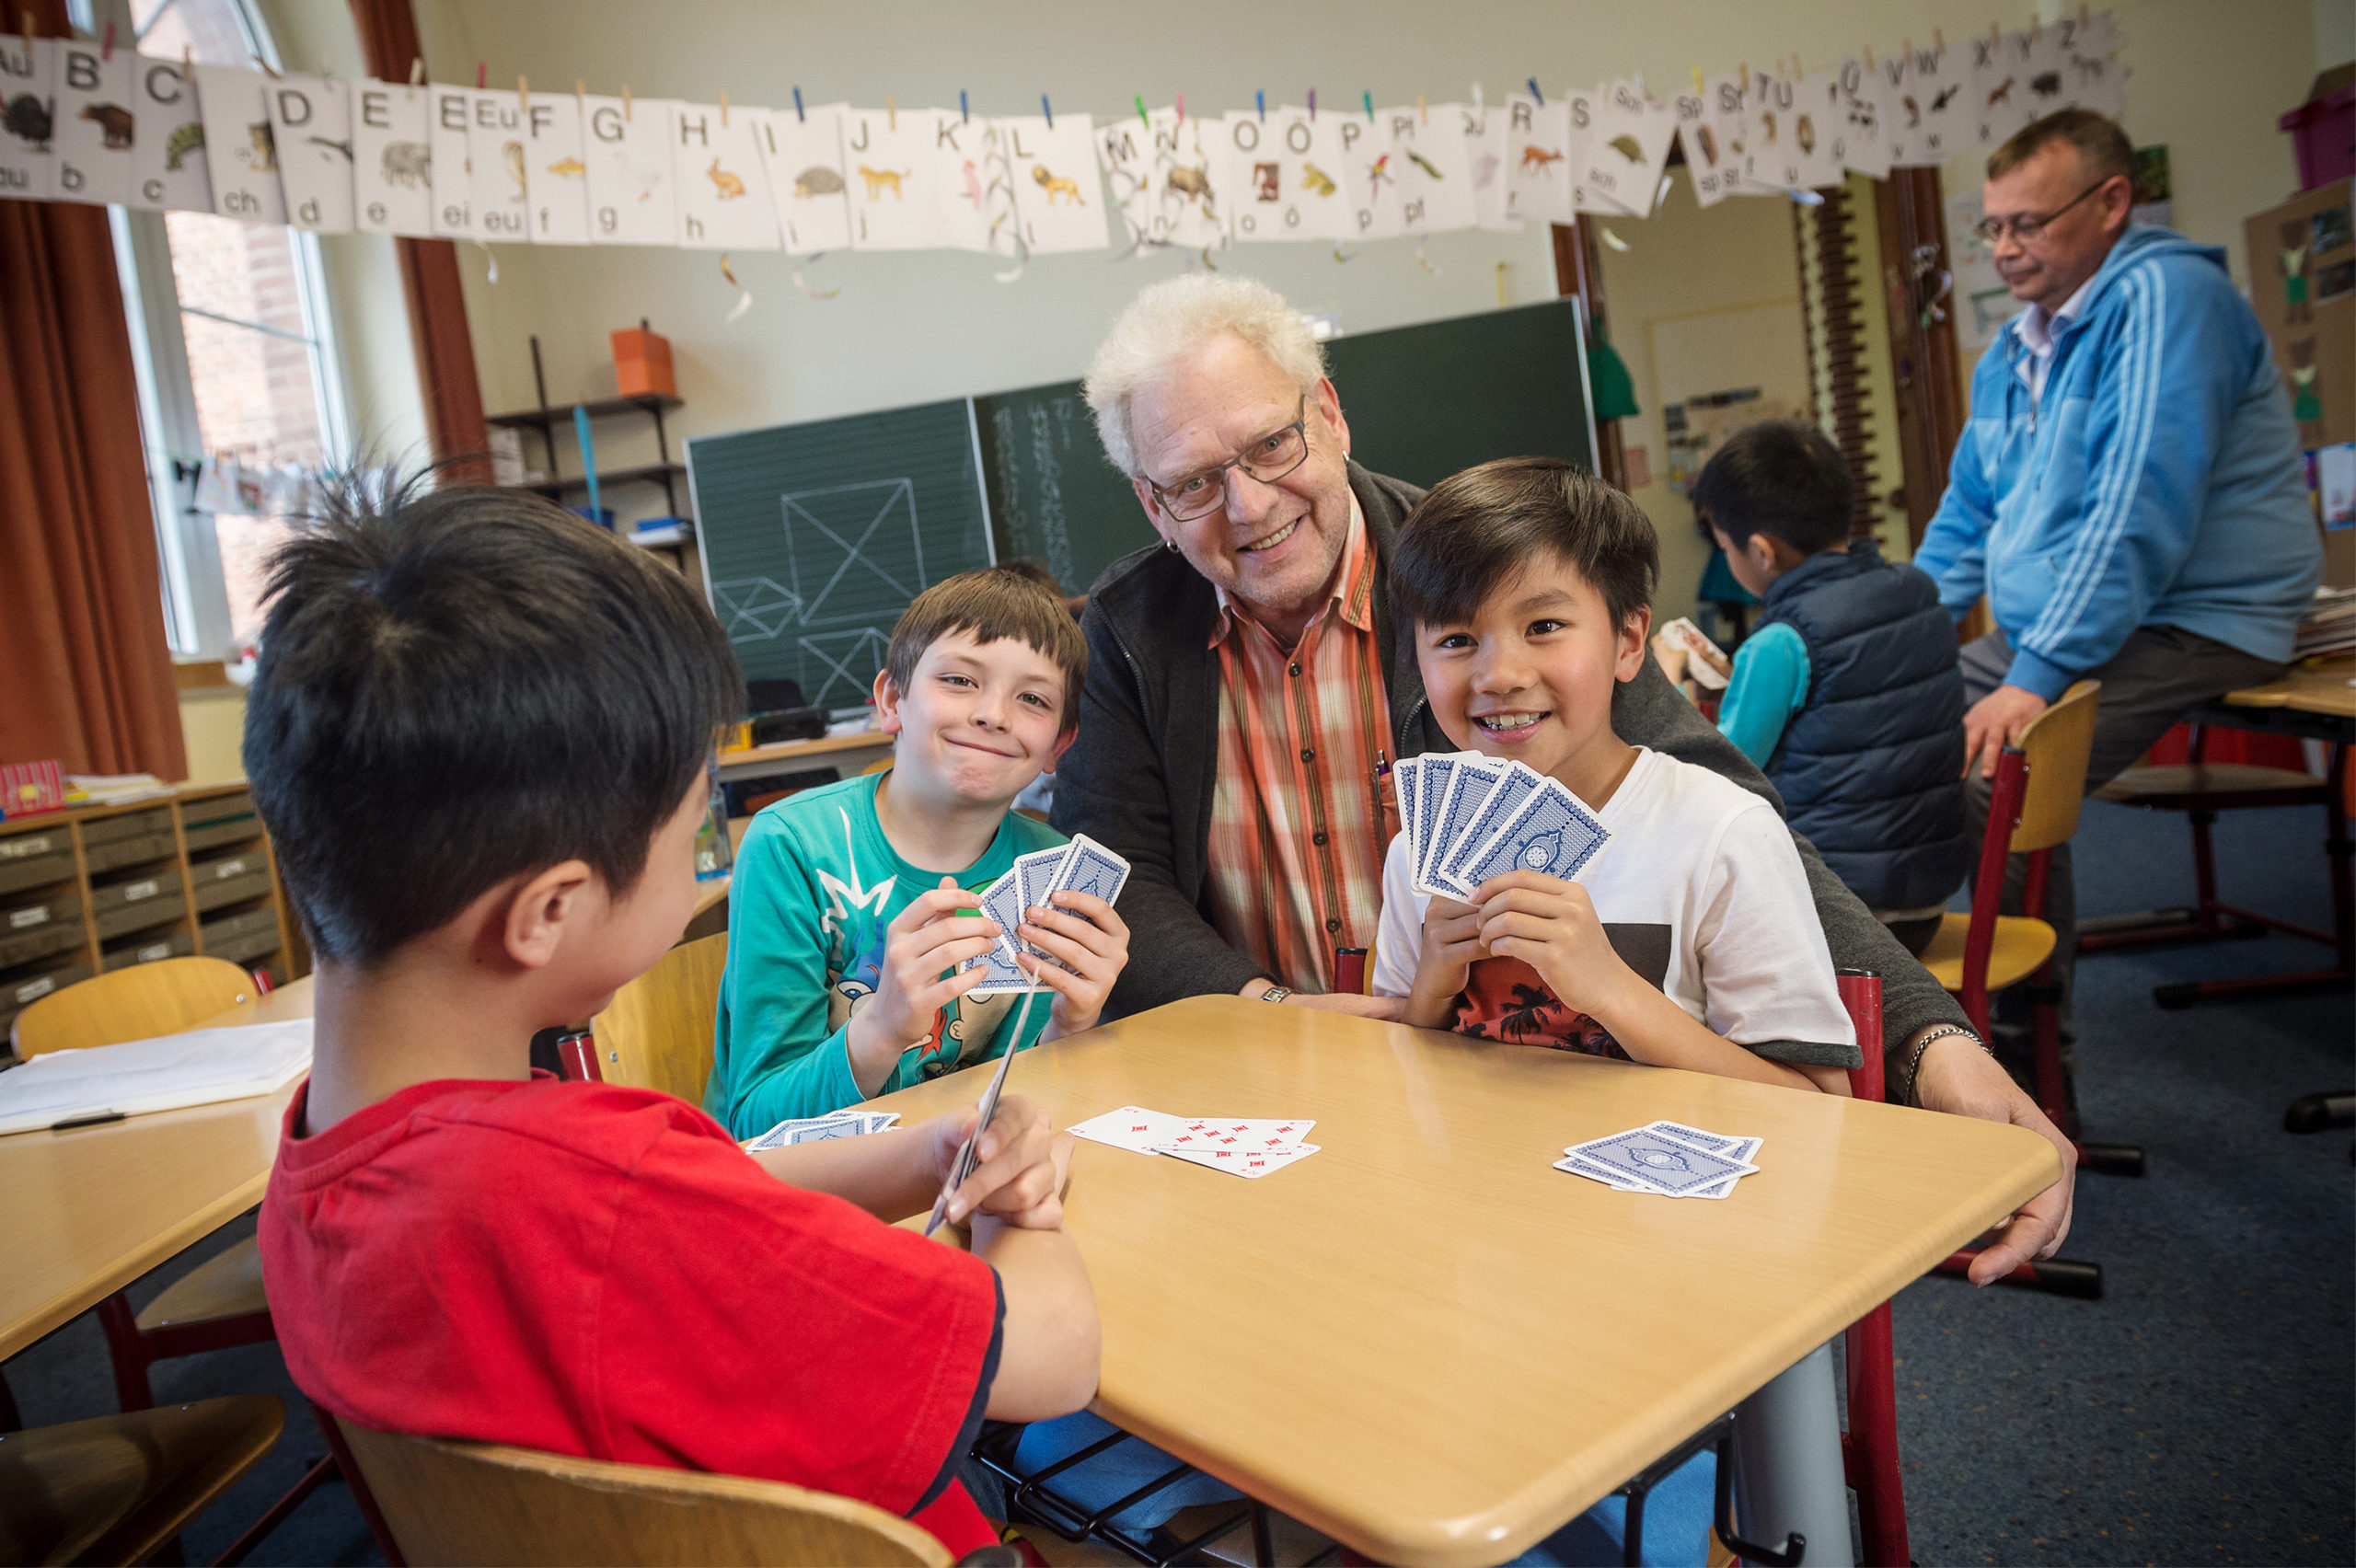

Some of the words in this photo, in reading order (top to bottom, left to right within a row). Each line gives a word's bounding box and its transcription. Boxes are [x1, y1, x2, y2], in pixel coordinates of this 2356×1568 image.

[66, 52, 100, 90] B
[145, 64, 183, 106] C
[1884, 58, 1904, 86] V
[278, 91, 311, 126] D
[363, 92, 389, 128] E
[1774, 79, 1794, 111] U
[476, 100, 518, 131] Eu
[531, 106, 553, 137] F
[593, 107, 626, 143] G
[1511, 101, 1532, 132] R
[1571, 97, 1590, 129] S
[681, 113, 708, 145] H
[851, 120, 869, 151] J
[937, 118, 961, 152] K
[1012, 127, 1034, 158] L
[1233, 120, 1259, 152] O
[1341, 122, 1360, 152] P
[1107, 132, 1138, 167] M
[61, 160, 85, 192] b
[143, 179, 165, 201] c
[224, 188, 260, 213] ch
[299, 197, 321, 225] d
[367, 202, 387, 225] e
[598, 206, 618, 233] g
[686, 213, 704, 238] h
[1241, 213, 1257, 234] o
